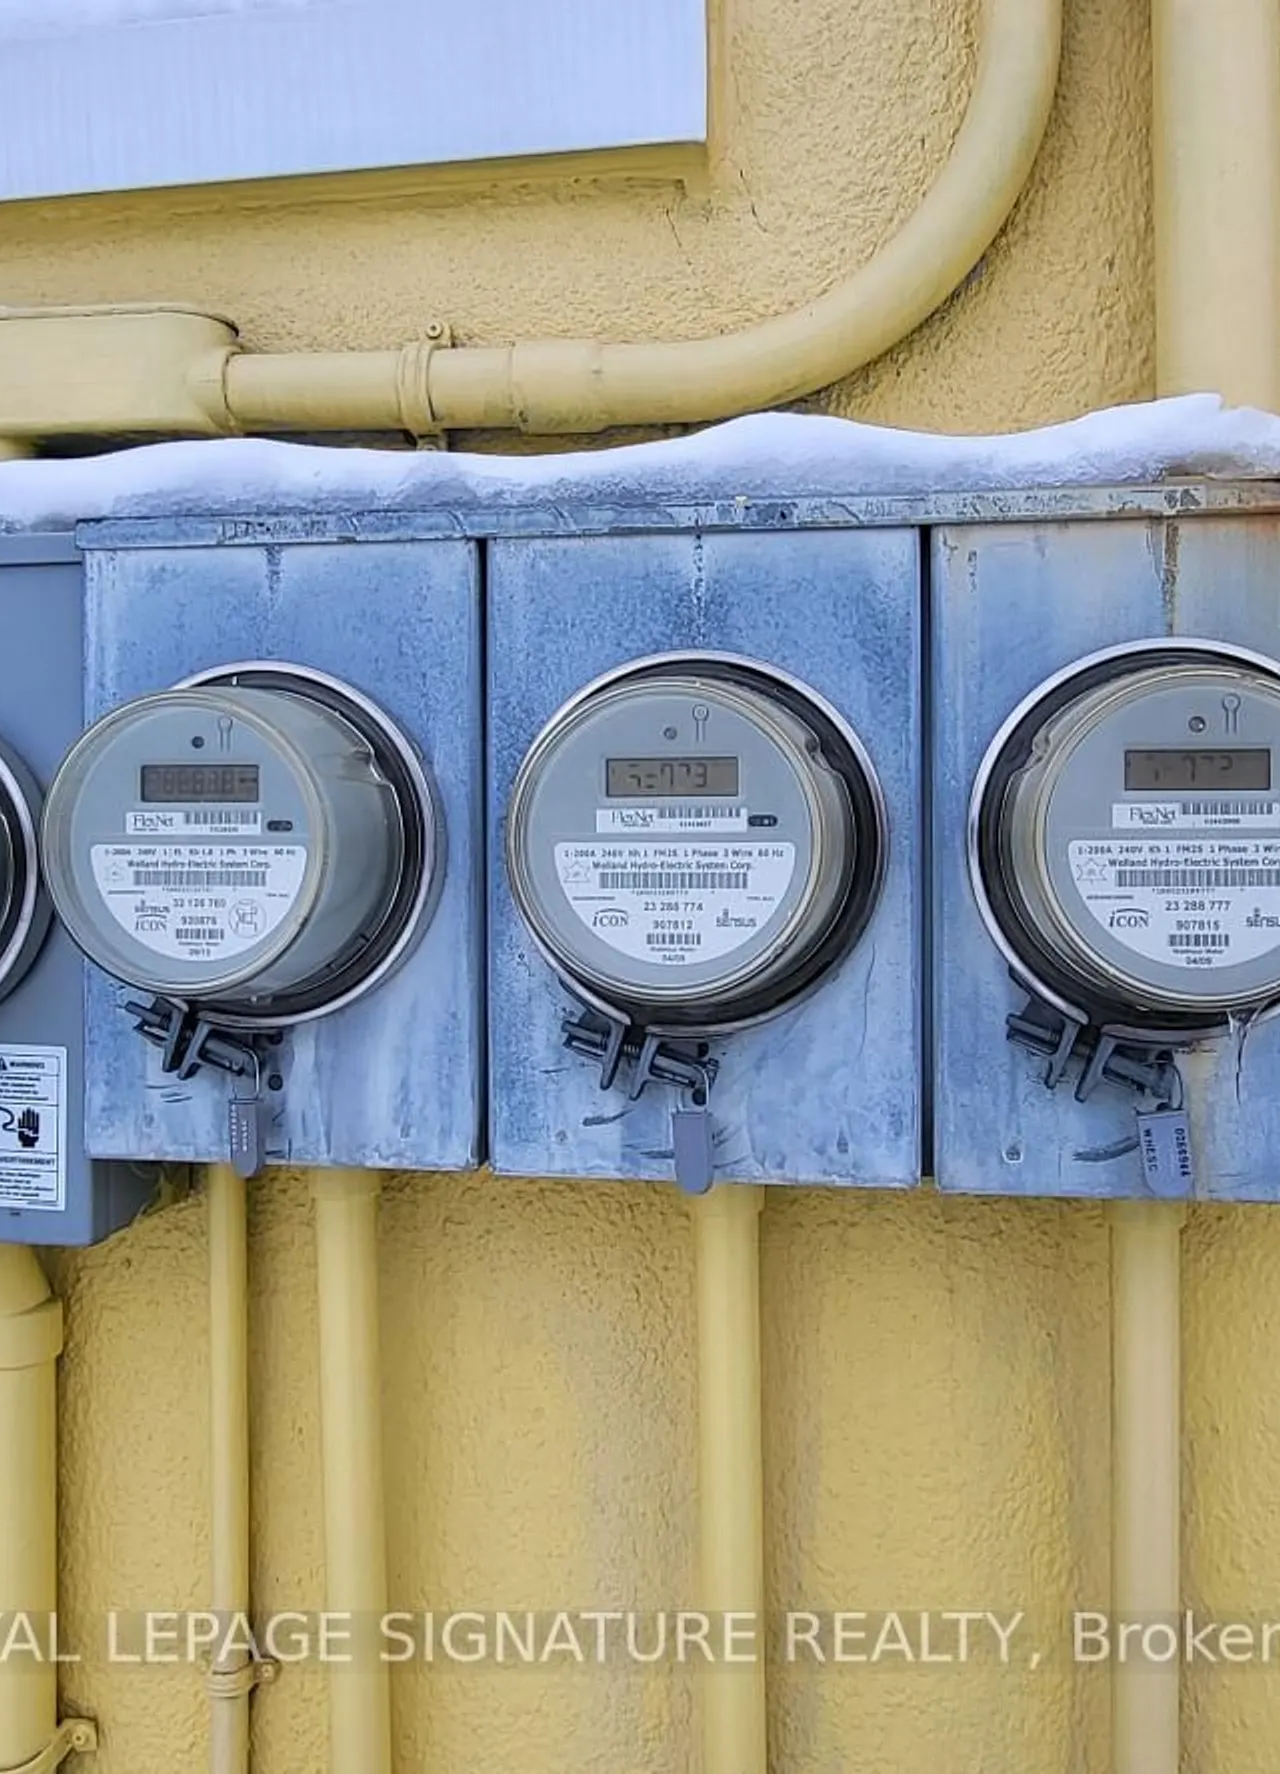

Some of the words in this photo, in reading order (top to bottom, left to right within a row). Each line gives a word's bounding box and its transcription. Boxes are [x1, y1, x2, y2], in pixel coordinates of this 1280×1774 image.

[133, 814, 174, 827] FlexNet
[731, 848, 753, 857] Wire
[1219, 845, 1248, 854] Phase
[160, 860, 216, 869] Hydro-Electric
[220, 860, 248, 869] System
[592, 861, 628, 870] Welland
[630, 861, 693, 871] Hydro-Electric
[696, 861, 728, 872] System
[1108, 858, 1147, 867] Welland
[1150, 858, 1220, 869] Hydro-Electric
[1223, 858, 1259, 869] System
[644, 902, 656, 911] 23
[1165, 900, 1179, 911] 23
[1183, 900, 1205, 911] 288
[1208, 900, 1231, 911] 777
